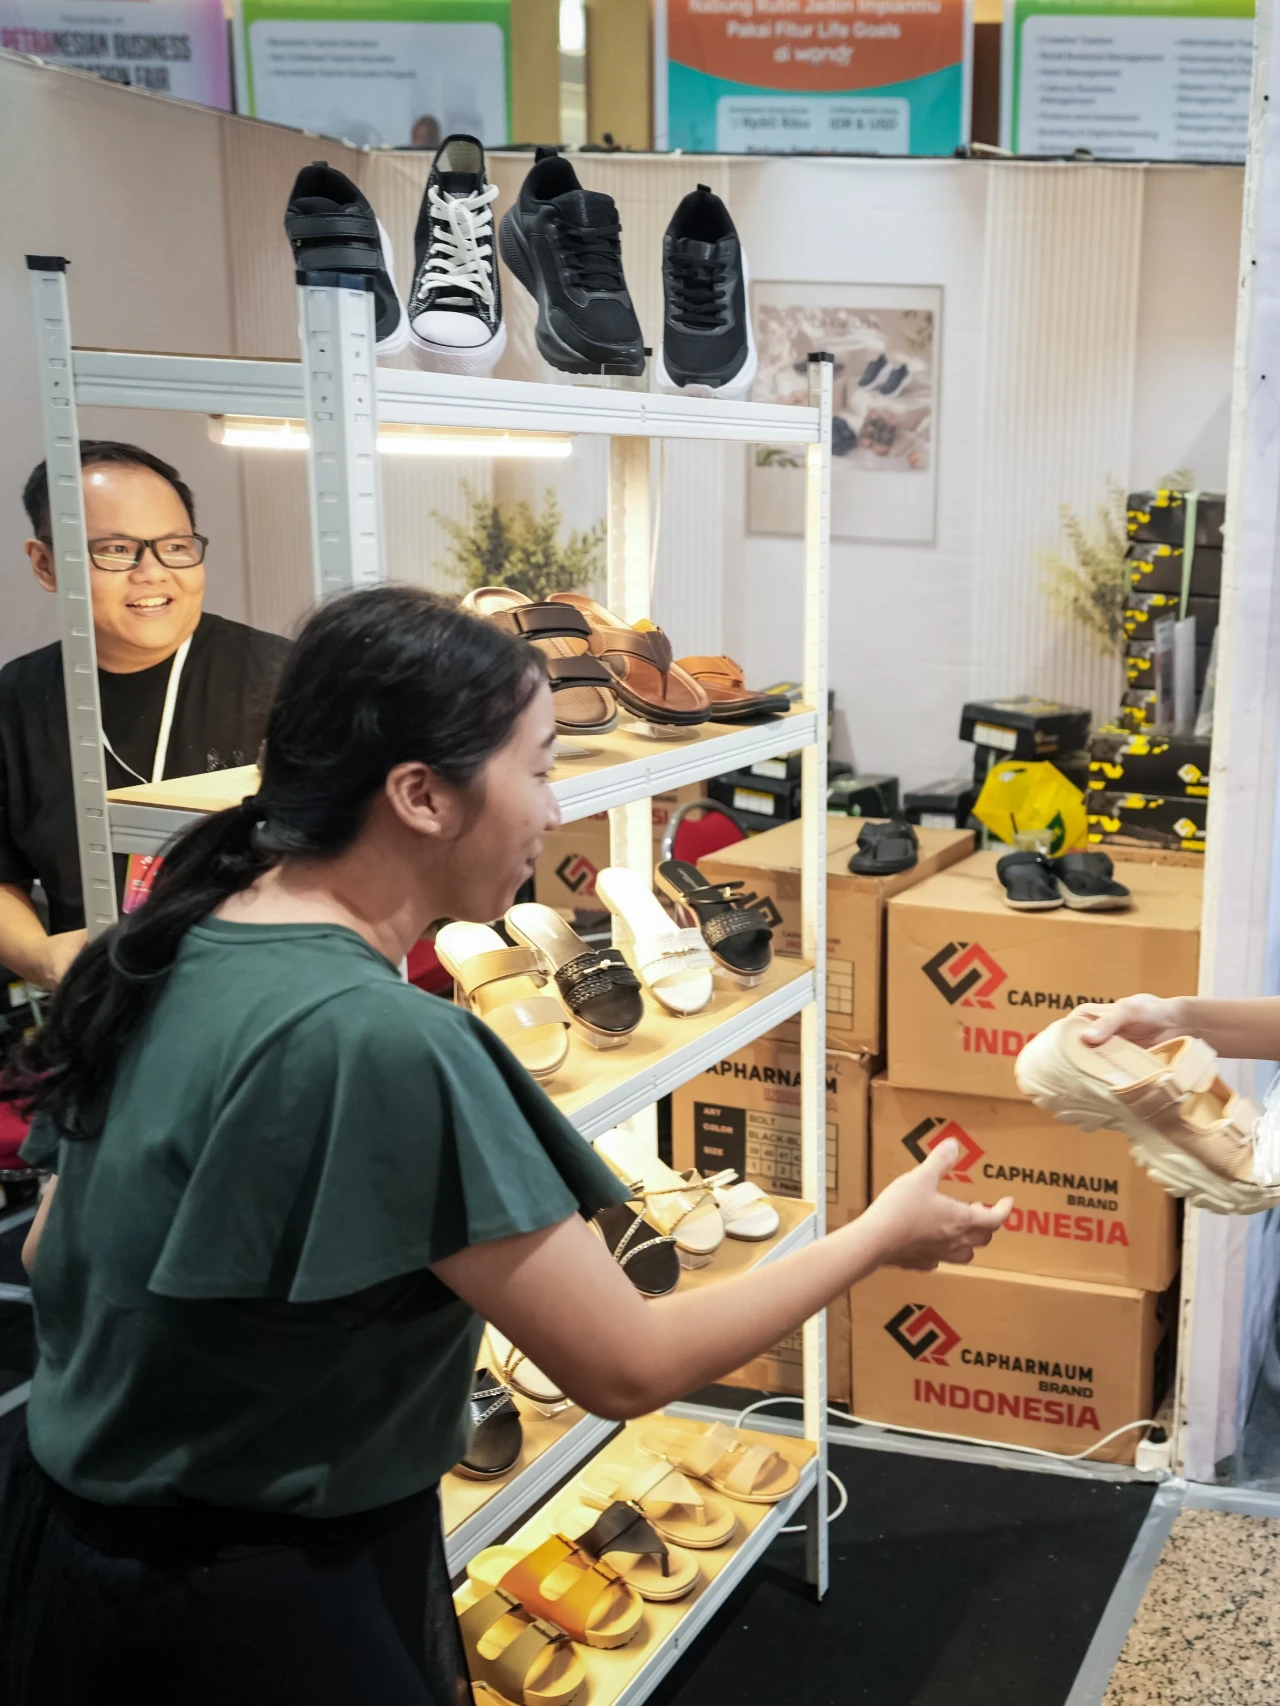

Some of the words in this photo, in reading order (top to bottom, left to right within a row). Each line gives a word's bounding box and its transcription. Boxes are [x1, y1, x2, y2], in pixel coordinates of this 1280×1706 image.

[727, 21, 771, 38] Pakai
[775, 21, 813, 38] Fitur
[817, 21, 849, 38] Life
[853, 21, 901, 38] Goals
[748, 1114, 776, 1127] BOLT
[748, 1130, 801, 1146] BLACK-BL
[983, 1163, 1118, 1194] CAPHARNAUM
[1067, 1195, 1118, 1211] BRAND
[1003, 1206, 1129, 1246] ONESIA
[961, 1348, 1093, 1382] CAPHARNAUM
[1039, 1381, 1093, 1398] BRAND
[914, 1378, 1101, 1430] INDONESIA
